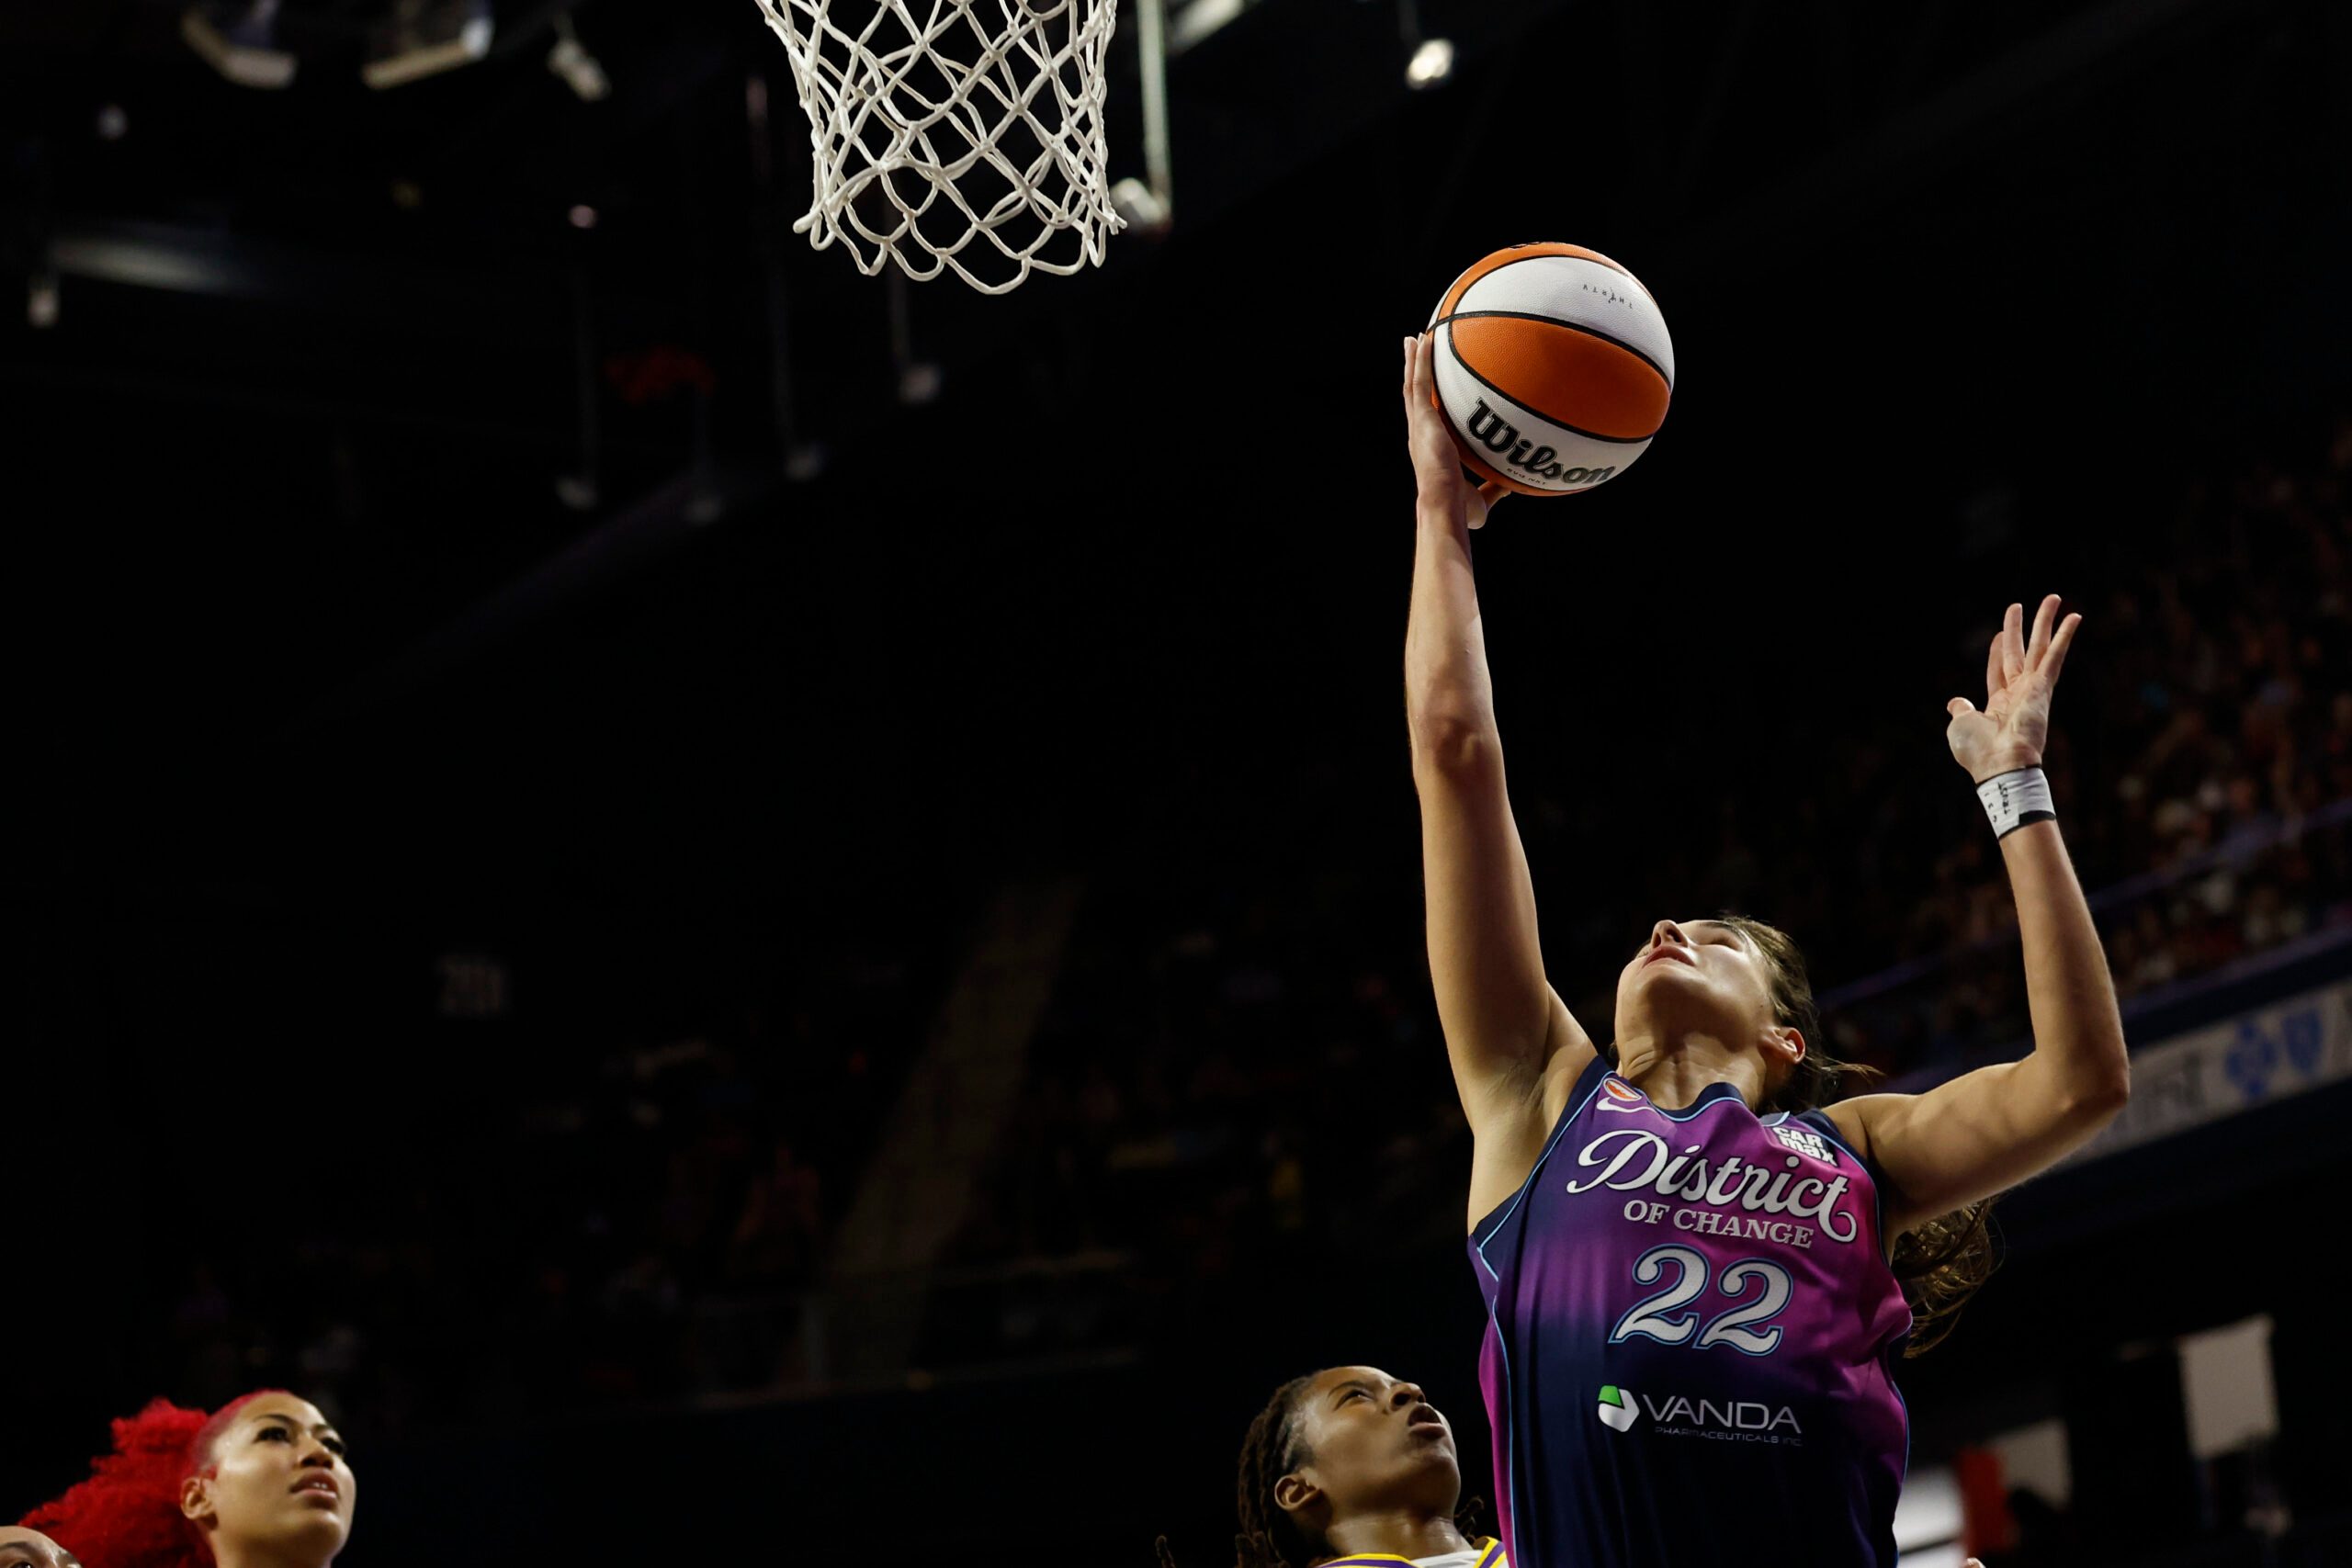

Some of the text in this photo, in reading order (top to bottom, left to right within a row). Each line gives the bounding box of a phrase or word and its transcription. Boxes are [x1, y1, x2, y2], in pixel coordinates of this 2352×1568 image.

[1467, 396, 1616, 483] Wilson
[1772, 1127, 1823, 1148] CAR
[1779, 1135, 1838, 1167] max
[1566, 1130, 1858, 1243] District
[1623, 1200, 1815, 1249] OF CHANGE
[1607, 1243, 1794, 1357] 22
[1642, 1393, 1803, 1434] VANDA
